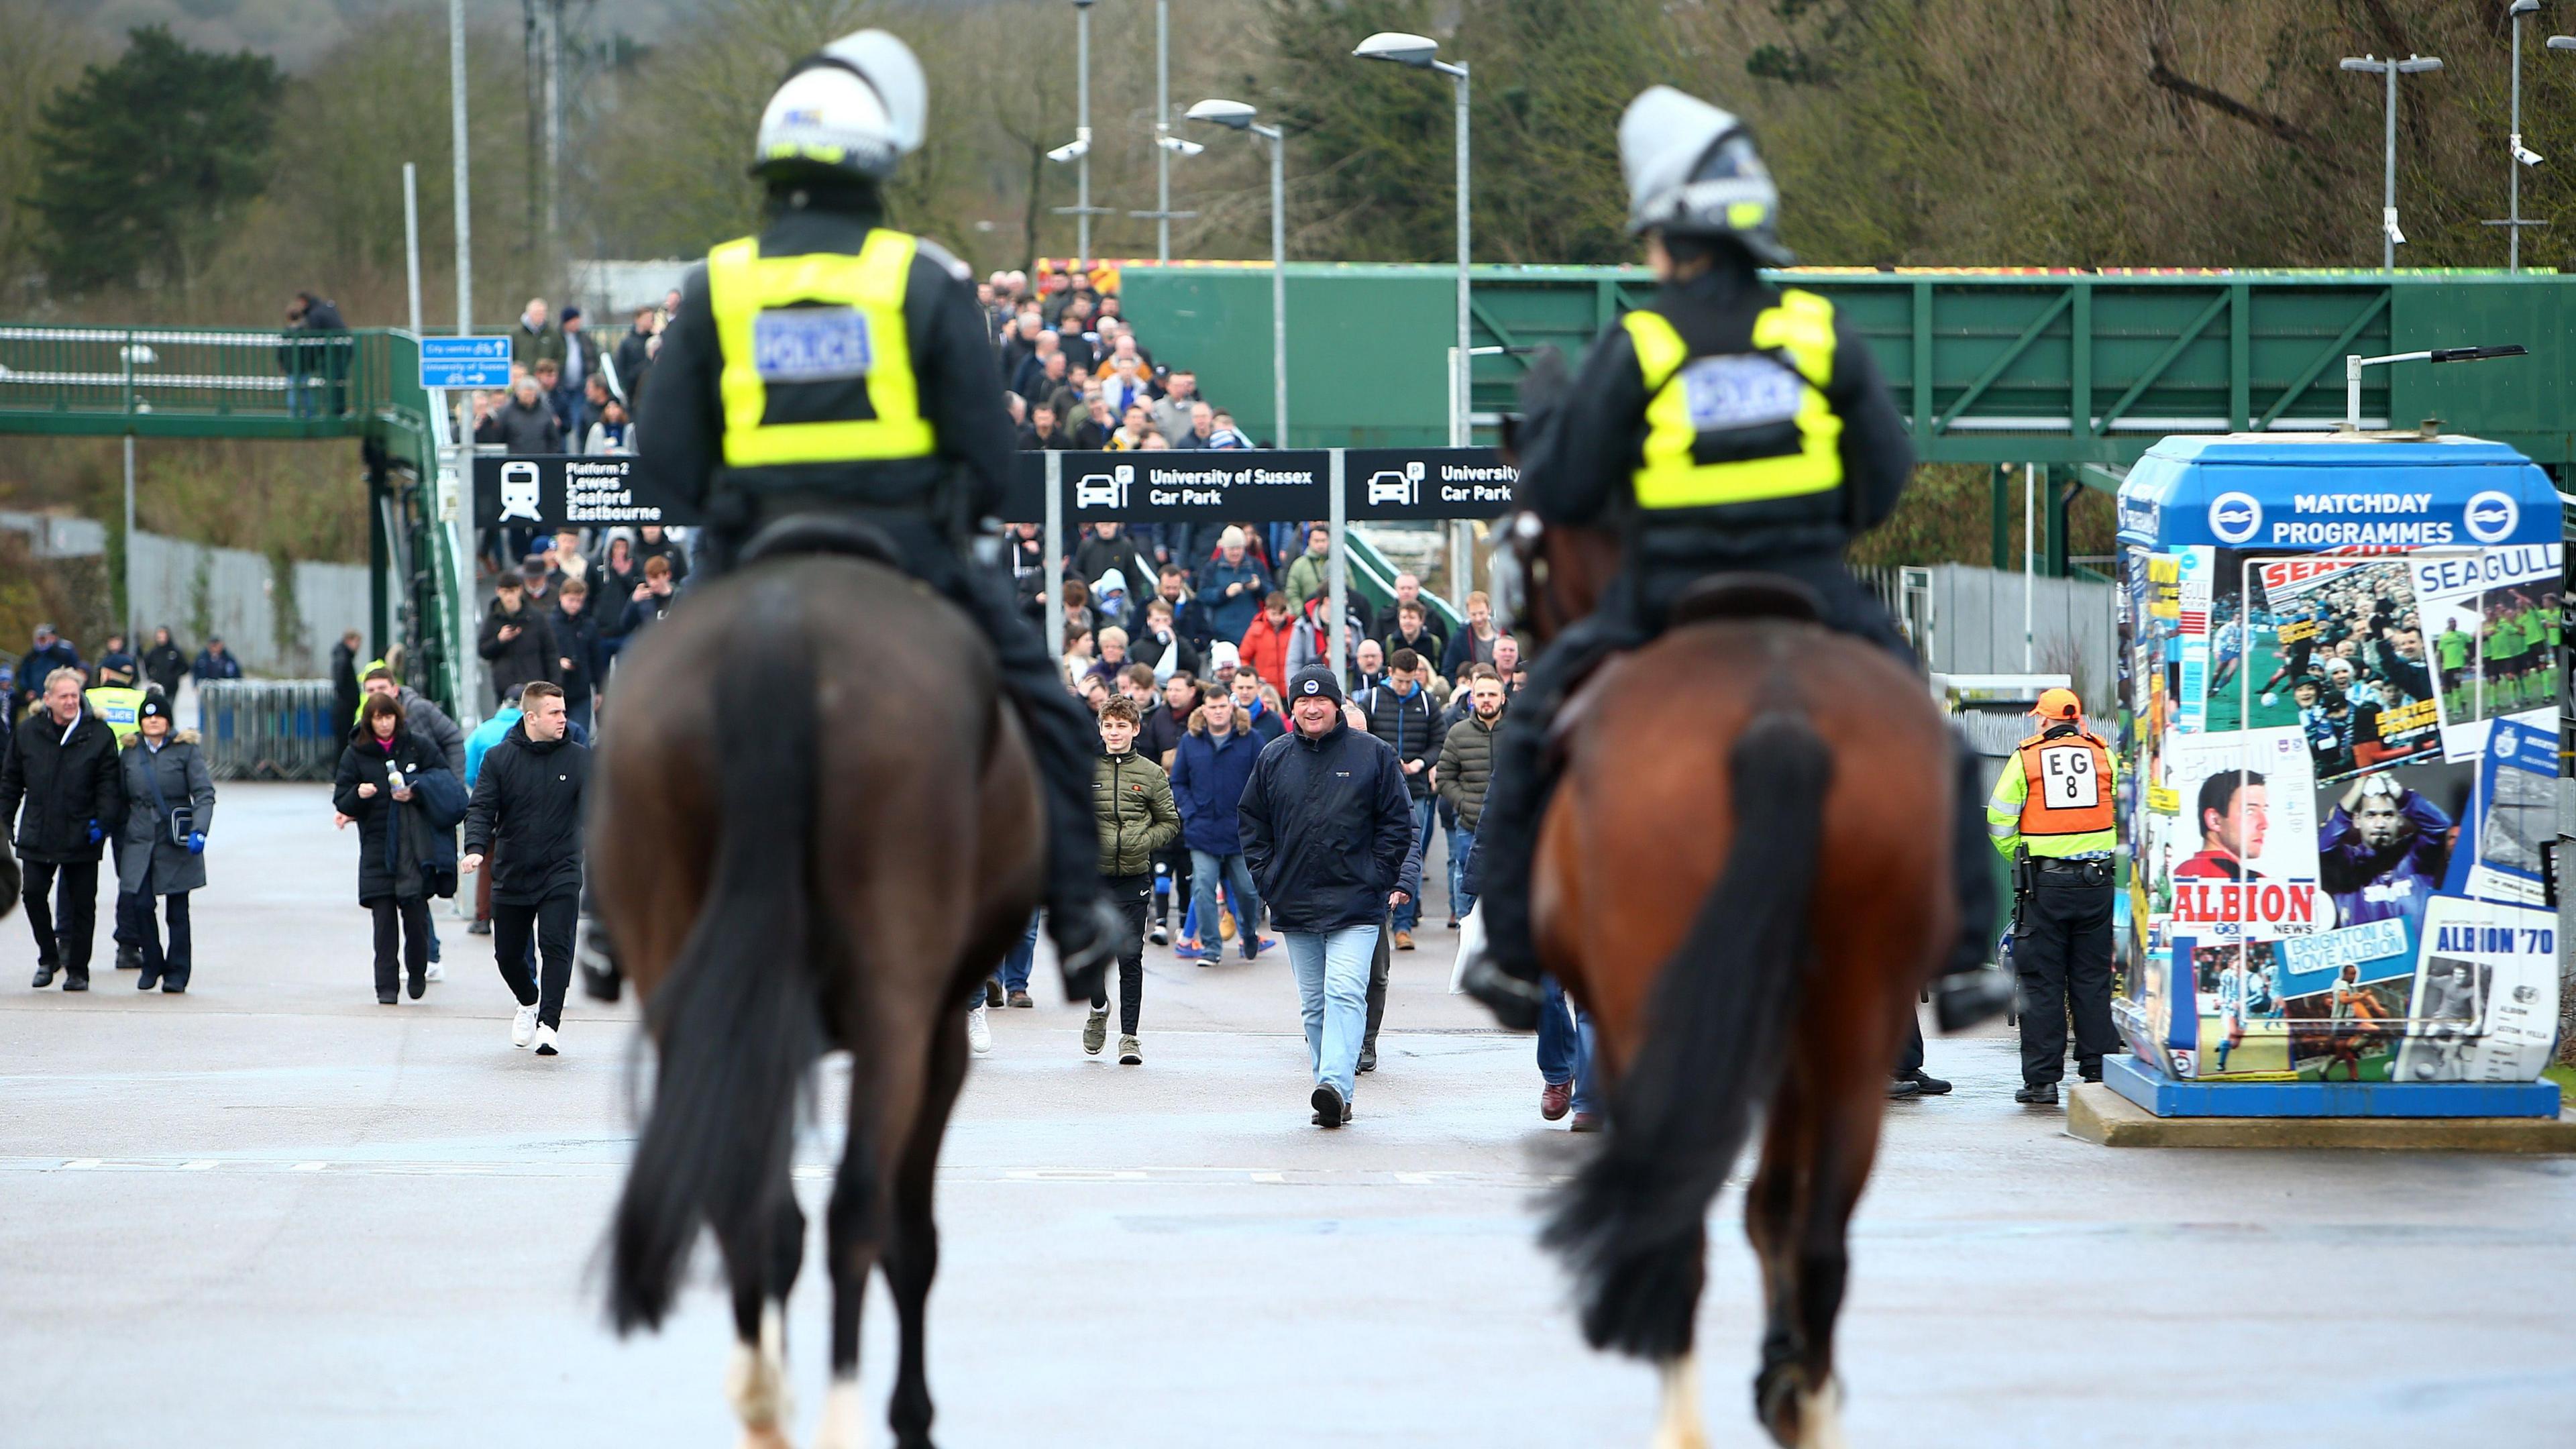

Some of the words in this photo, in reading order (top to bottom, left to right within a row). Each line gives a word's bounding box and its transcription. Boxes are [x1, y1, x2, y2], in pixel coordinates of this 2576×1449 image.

[566, 462, 620, 476] Platform
[620, 462, 630, 476] 2
[1149, 468, 1233, 488] University
[1234, 468, 1252, 485] of
[1254, 468, 1313, 485] Sussex
[1441, 464, 1520, 483] University
[566, 474, 621, 491] Lewes
[566, 488, 632, 506] Seaford
[1149, 489, 1180, 505] Car
[1182, 488, 1222, 505] Park
[1441, 484, 1470, 502] Car
[1473, 484, 1512, 502] Park
[566, 504, 662, 521] Eastbourne
[2294, 493, 2432, 514] MATCHDAY
[2272, 521, 2454, 544] PROGRAMMES
[2421, 544, 2563, 592] SEAGULL
[2377, 710, 2438, 737] PROMI
[2066, 775, 2078, 798] 8
[2172, 884, 2314, 922] ALBION
[2273, 924, 2314, 935] NEWS
[2291, 925, 2377, 955] BRIGHTON
[2382, 922, 2396, 937] &
[2436, 926, 2514, 953] ALBION
[2289, 949, 2335, 971] HOVE
[2341, 936, 2403, 960] ALBION
